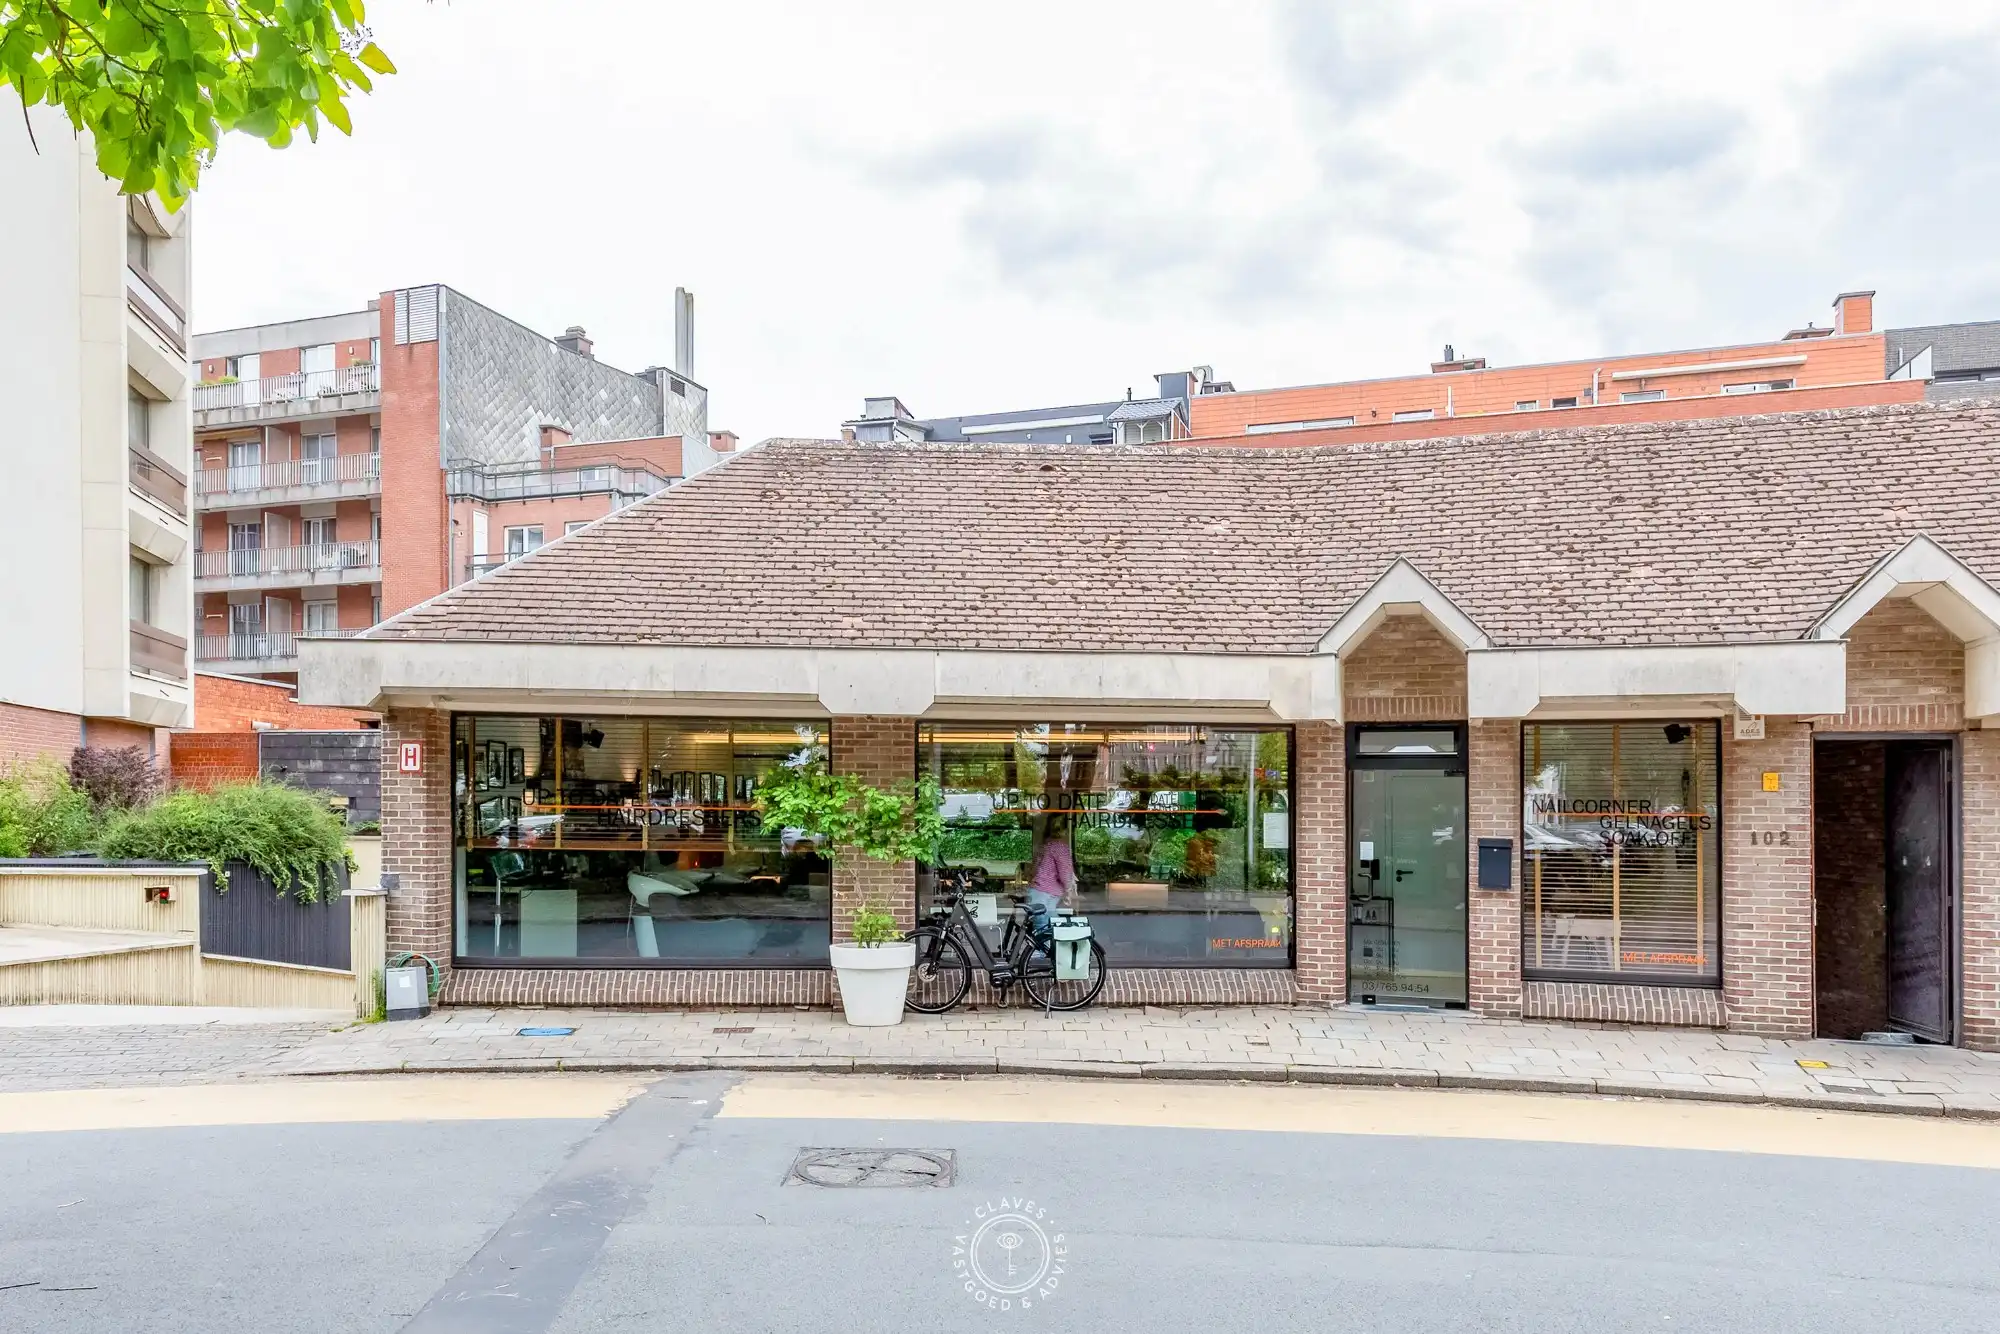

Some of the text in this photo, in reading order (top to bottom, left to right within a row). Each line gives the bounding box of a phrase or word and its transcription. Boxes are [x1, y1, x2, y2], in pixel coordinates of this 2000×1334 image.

[404, 747, 417, 767] H
[523, 788, 551, 806] UP
[993, 793, 1108, 811] UP TO DATE
[1532, 799, 1652, 814] NAILCORNER
[598, 808, 762, 827] HAIRDRESSERS
[1064, 811, 1194, 829] HAIRDRESSE
[1600, 815, 1712, 831] GELNAGELS
[1751, 831, 1790, 846] 102
[1212, 938, 1282, 949] MET AFSPRAAK
[1623, 952, 1646, 963] MET
[1362, 982, 1430, 993] 03/765.94.54
